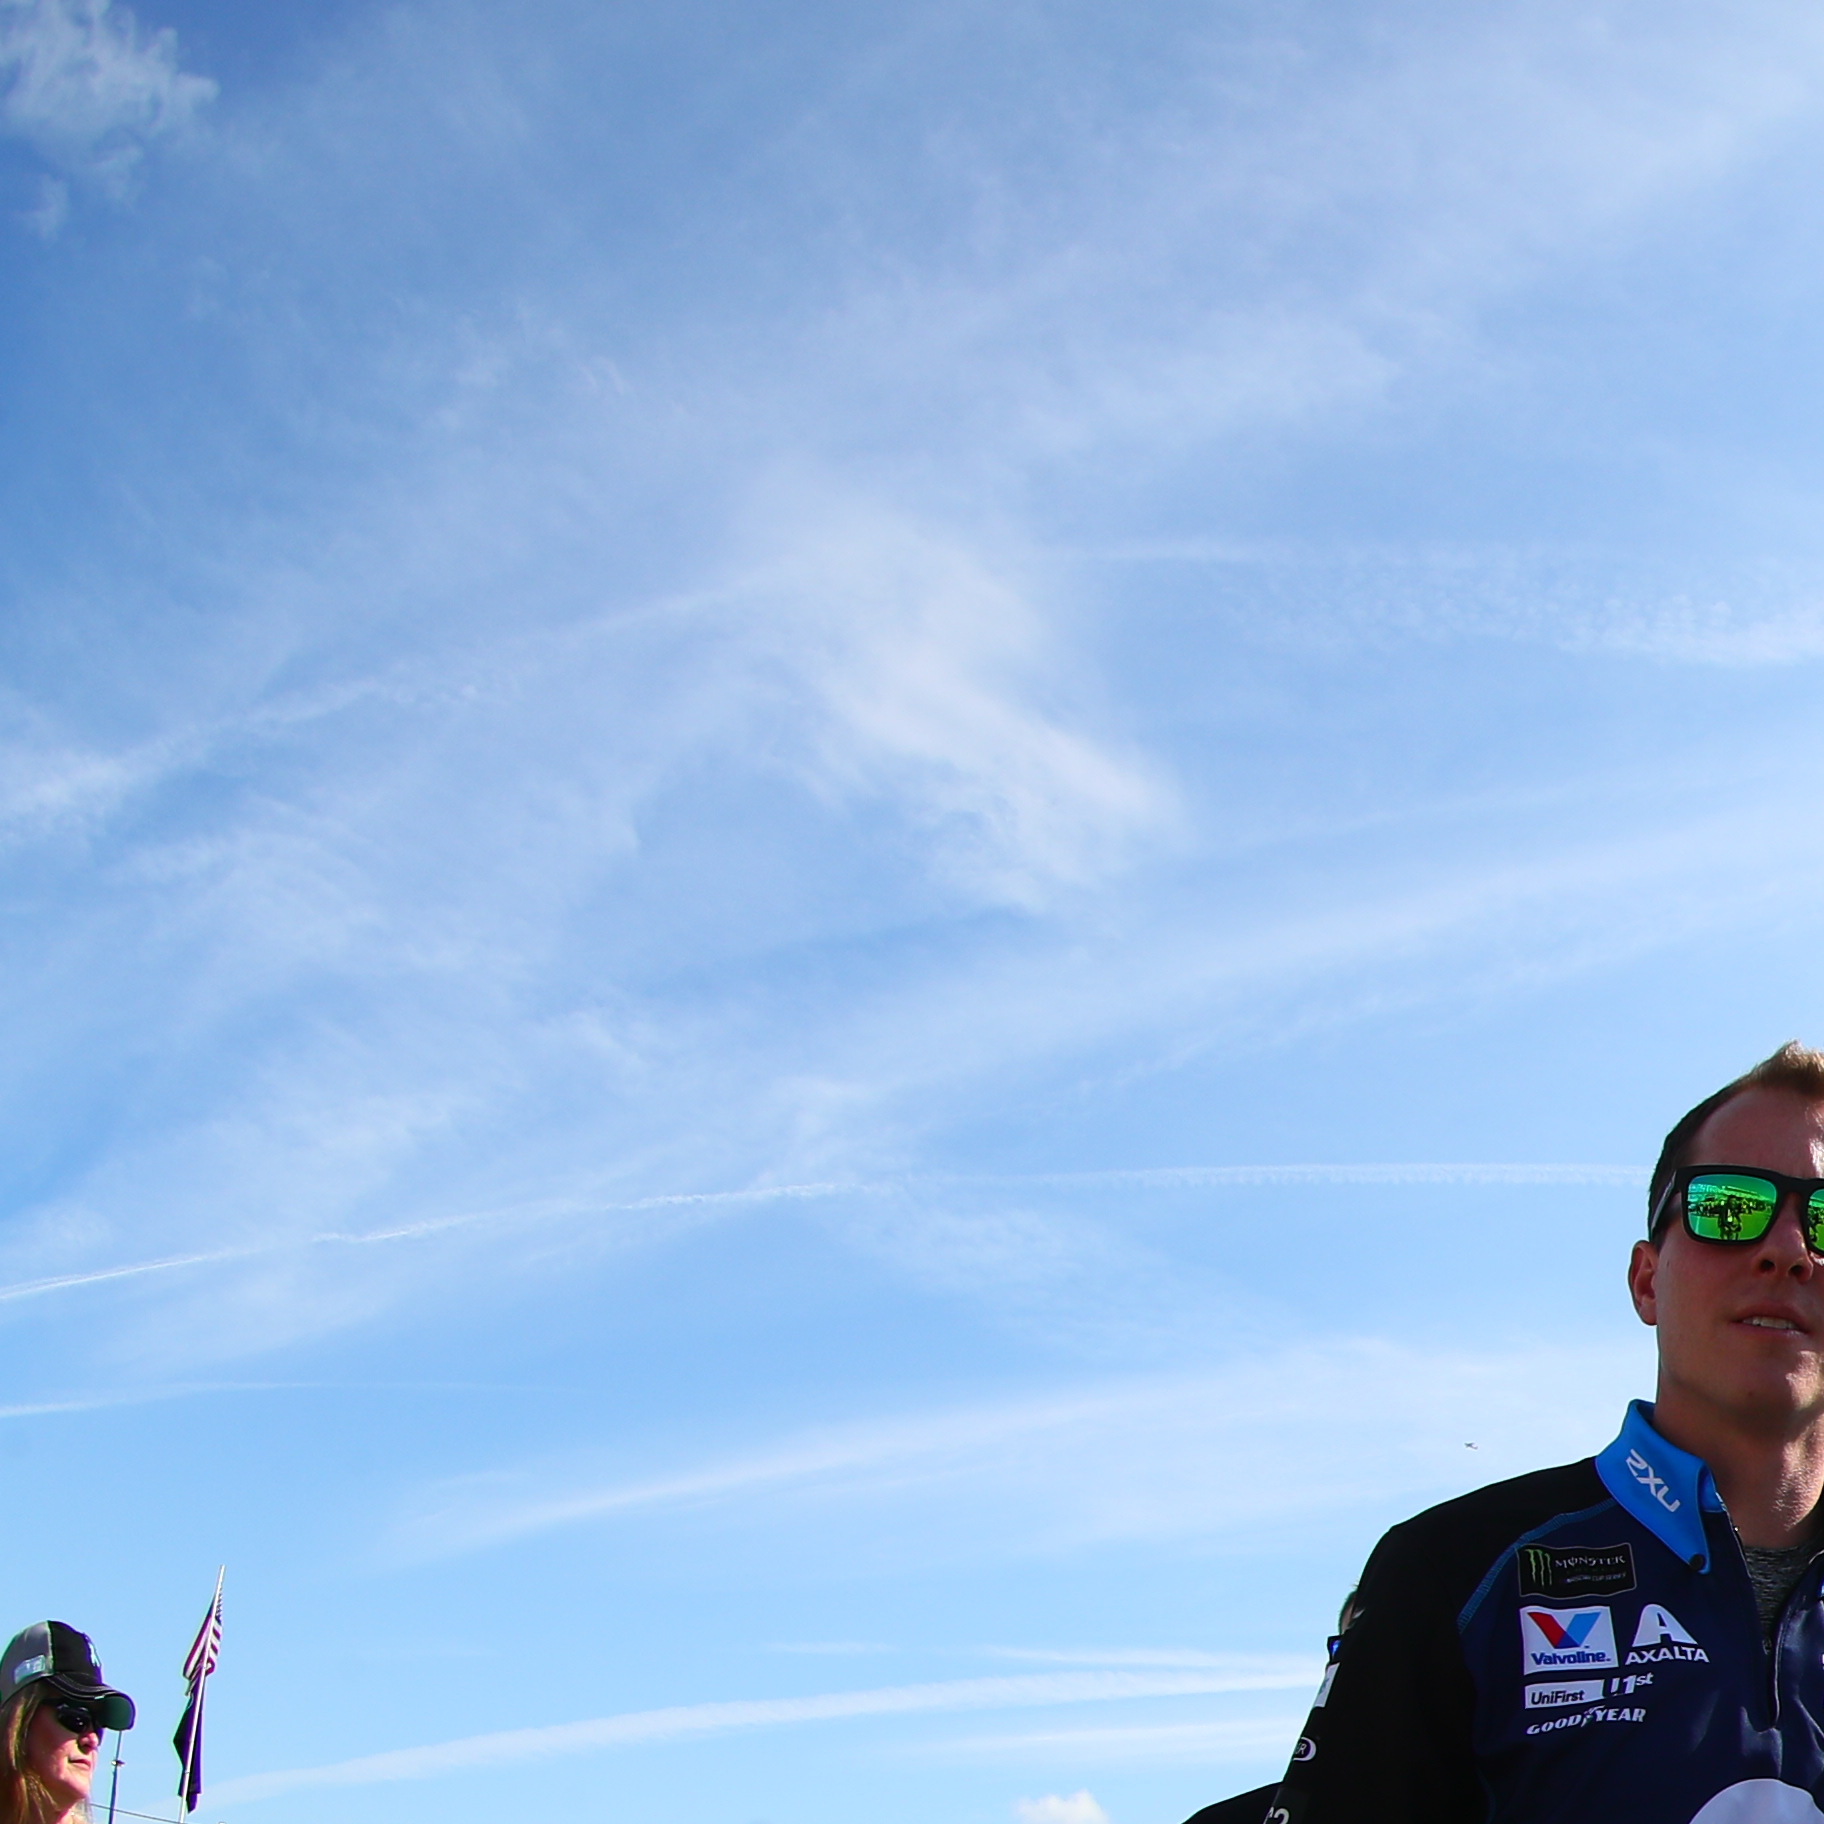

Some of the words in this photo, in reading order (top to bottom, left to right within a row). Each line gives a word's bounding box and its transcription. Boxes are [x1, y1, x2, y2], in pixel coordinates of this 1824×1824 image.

[1626, 1448, 1681, 1513] 2XU
[1531, 1651, 1606, 1666] Valvoline
[1624, 1646, 1710, 1666] AXALTA
[1530, 1687, 1585, 1705] UniFirst
